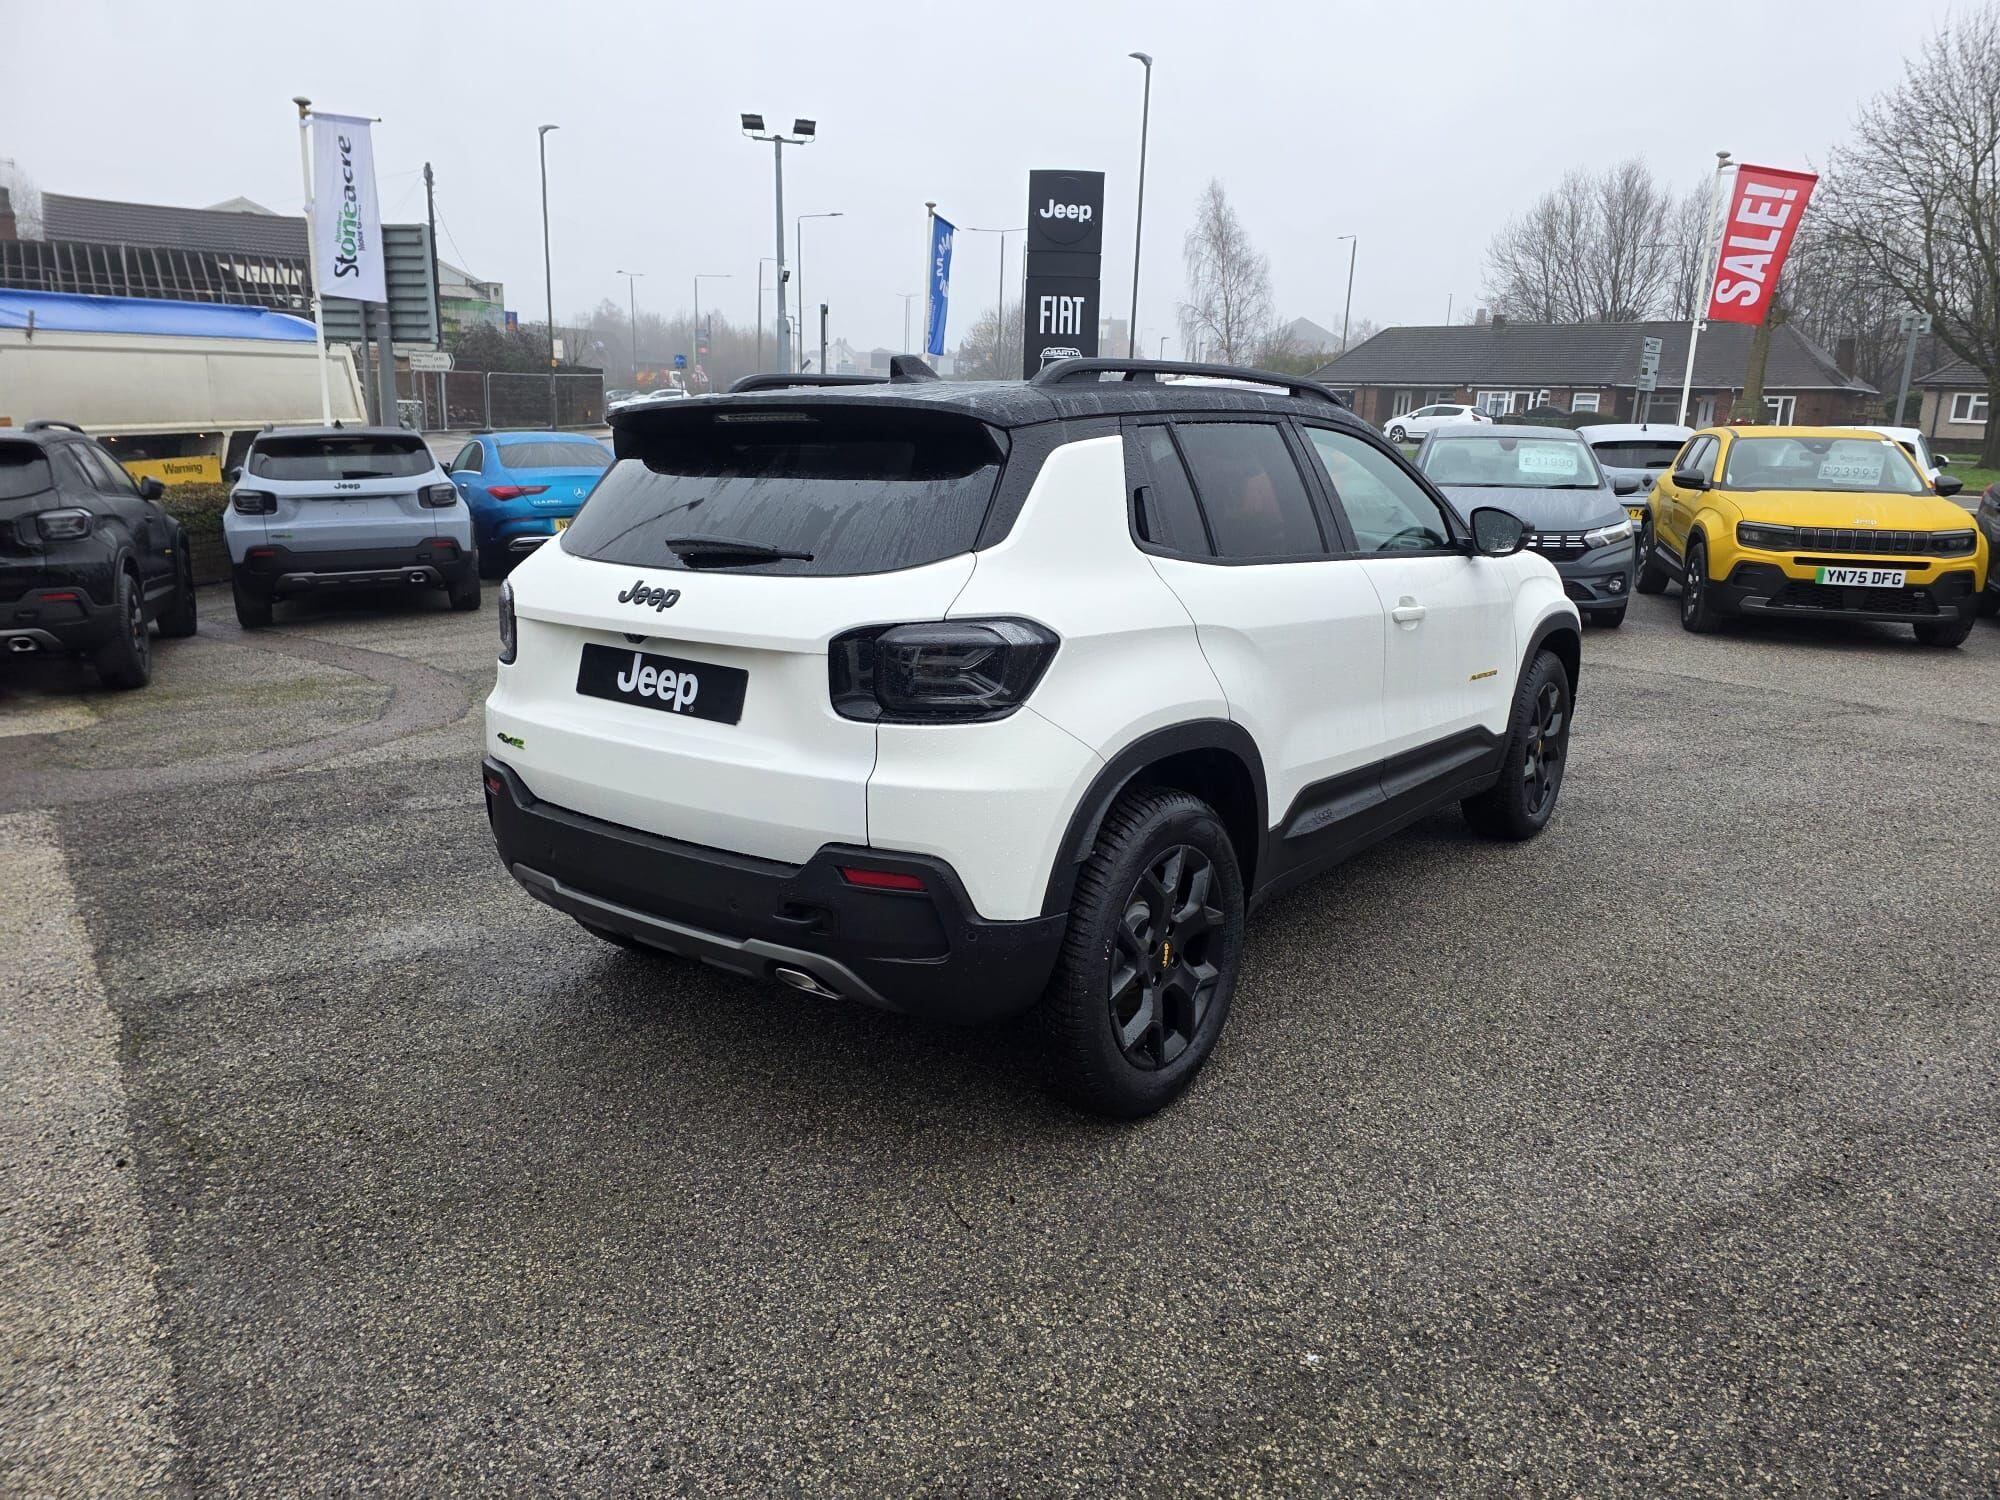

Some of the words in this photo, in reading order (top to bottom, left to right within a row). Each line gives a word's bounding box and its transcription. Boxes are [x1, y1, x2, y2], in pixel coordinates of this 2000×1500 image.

[334, 136, 359, 278] Stoneacre
[1039, 199, 1092, 222] Jeep
[1715, 182, 1798, 306] SALE!
[1039, 295, 1085, 335] FIAT
[1044, 349, 1080, 357] ABARTH
[163, 462, 203, 475] Warning
[1823, 465, 1880, 479] £23995
[334, 482, 361, 490] Jeep
[1827, 569, 1868, 583] YN75
[1871, 571, 1902, 585] DFG
[618, 580, 681, 612] Jeep
[617, 653, 699, 712] Jeep
